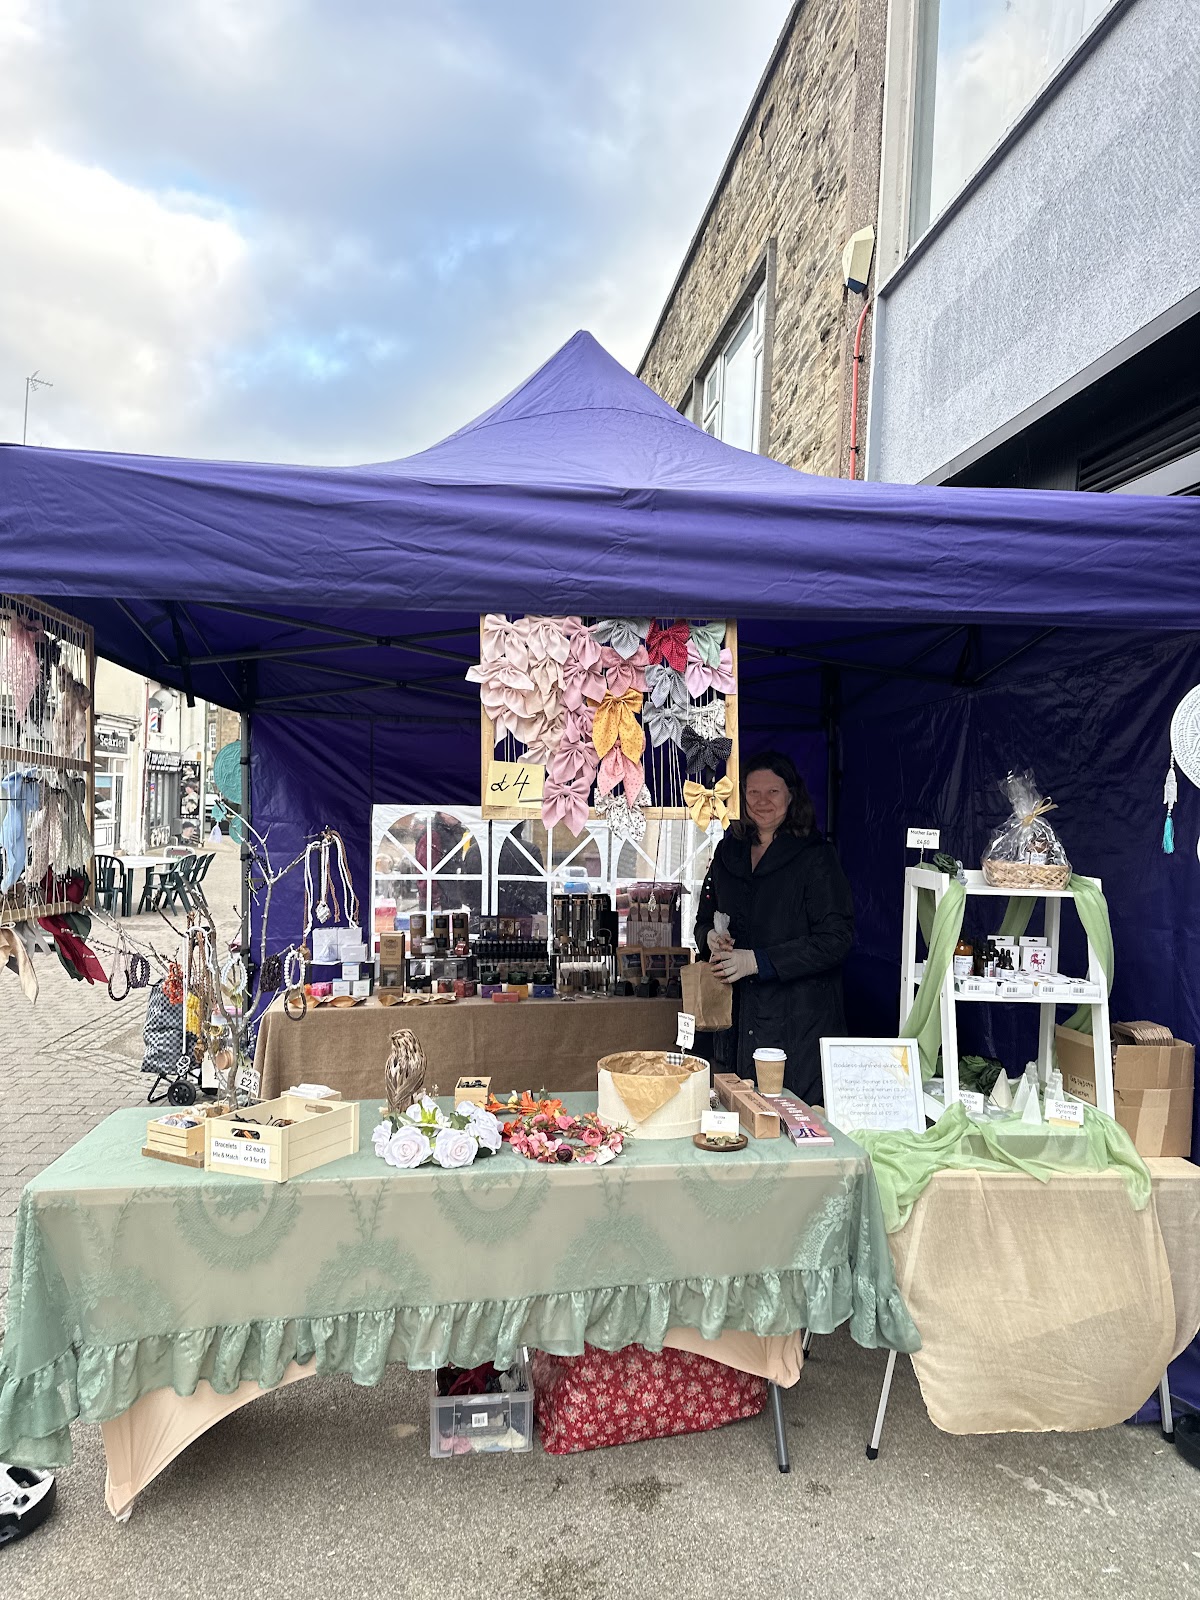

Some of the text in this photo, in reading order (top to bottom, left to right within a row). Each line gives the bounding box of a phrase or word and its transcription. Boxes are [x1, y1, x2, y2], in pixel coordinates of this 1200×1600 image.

[99, 733, 125, 748] Scarlet
[242, 1069, 252, 1078] Key
[1054, 1101, 1078, 1110] Selenite
[214, 1140, 238, 1150] Bracelets
[245, 1144, 266, 1154] £2 each
[225, 1153, 239, 1161] Match
